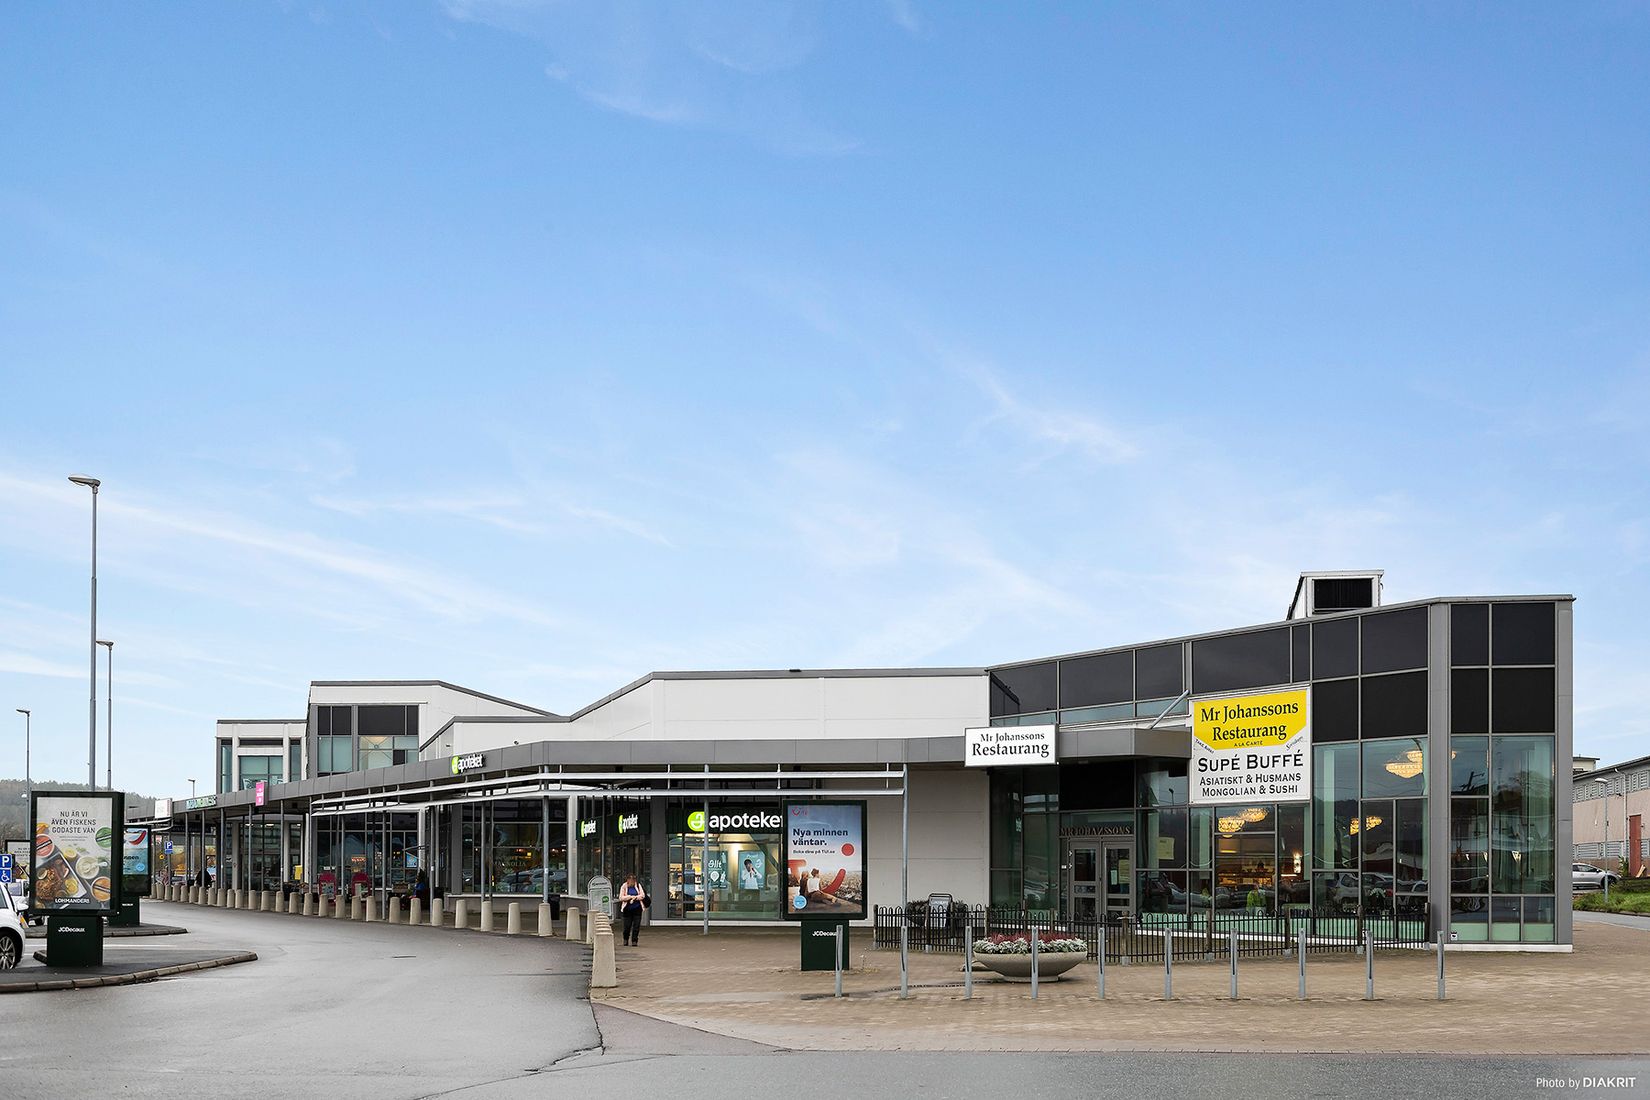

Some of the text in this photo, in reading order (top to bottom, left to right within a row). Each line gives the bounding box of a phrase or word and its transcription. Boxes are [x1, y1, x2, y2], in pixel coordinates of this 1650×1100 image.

[1201, 702, 1299, 724] Mr Johanssons
[980, 732, 1045, 744] Mr Johanssons
[1213, 724, 1287, 741] Restaurang
[972, 743, 1050, 758] Restaurang
[1198, 749, 1303, 772] SUPÉ BUFFÉ
[1200, 772, 1302, 786] ASIATISKT & HUSMANS
[1202, 784, 1298, 797] MONGOLIAN & SUSHI
[793, 828, 848, 837] Nya minnen
[2, 856, 10, 867] P
